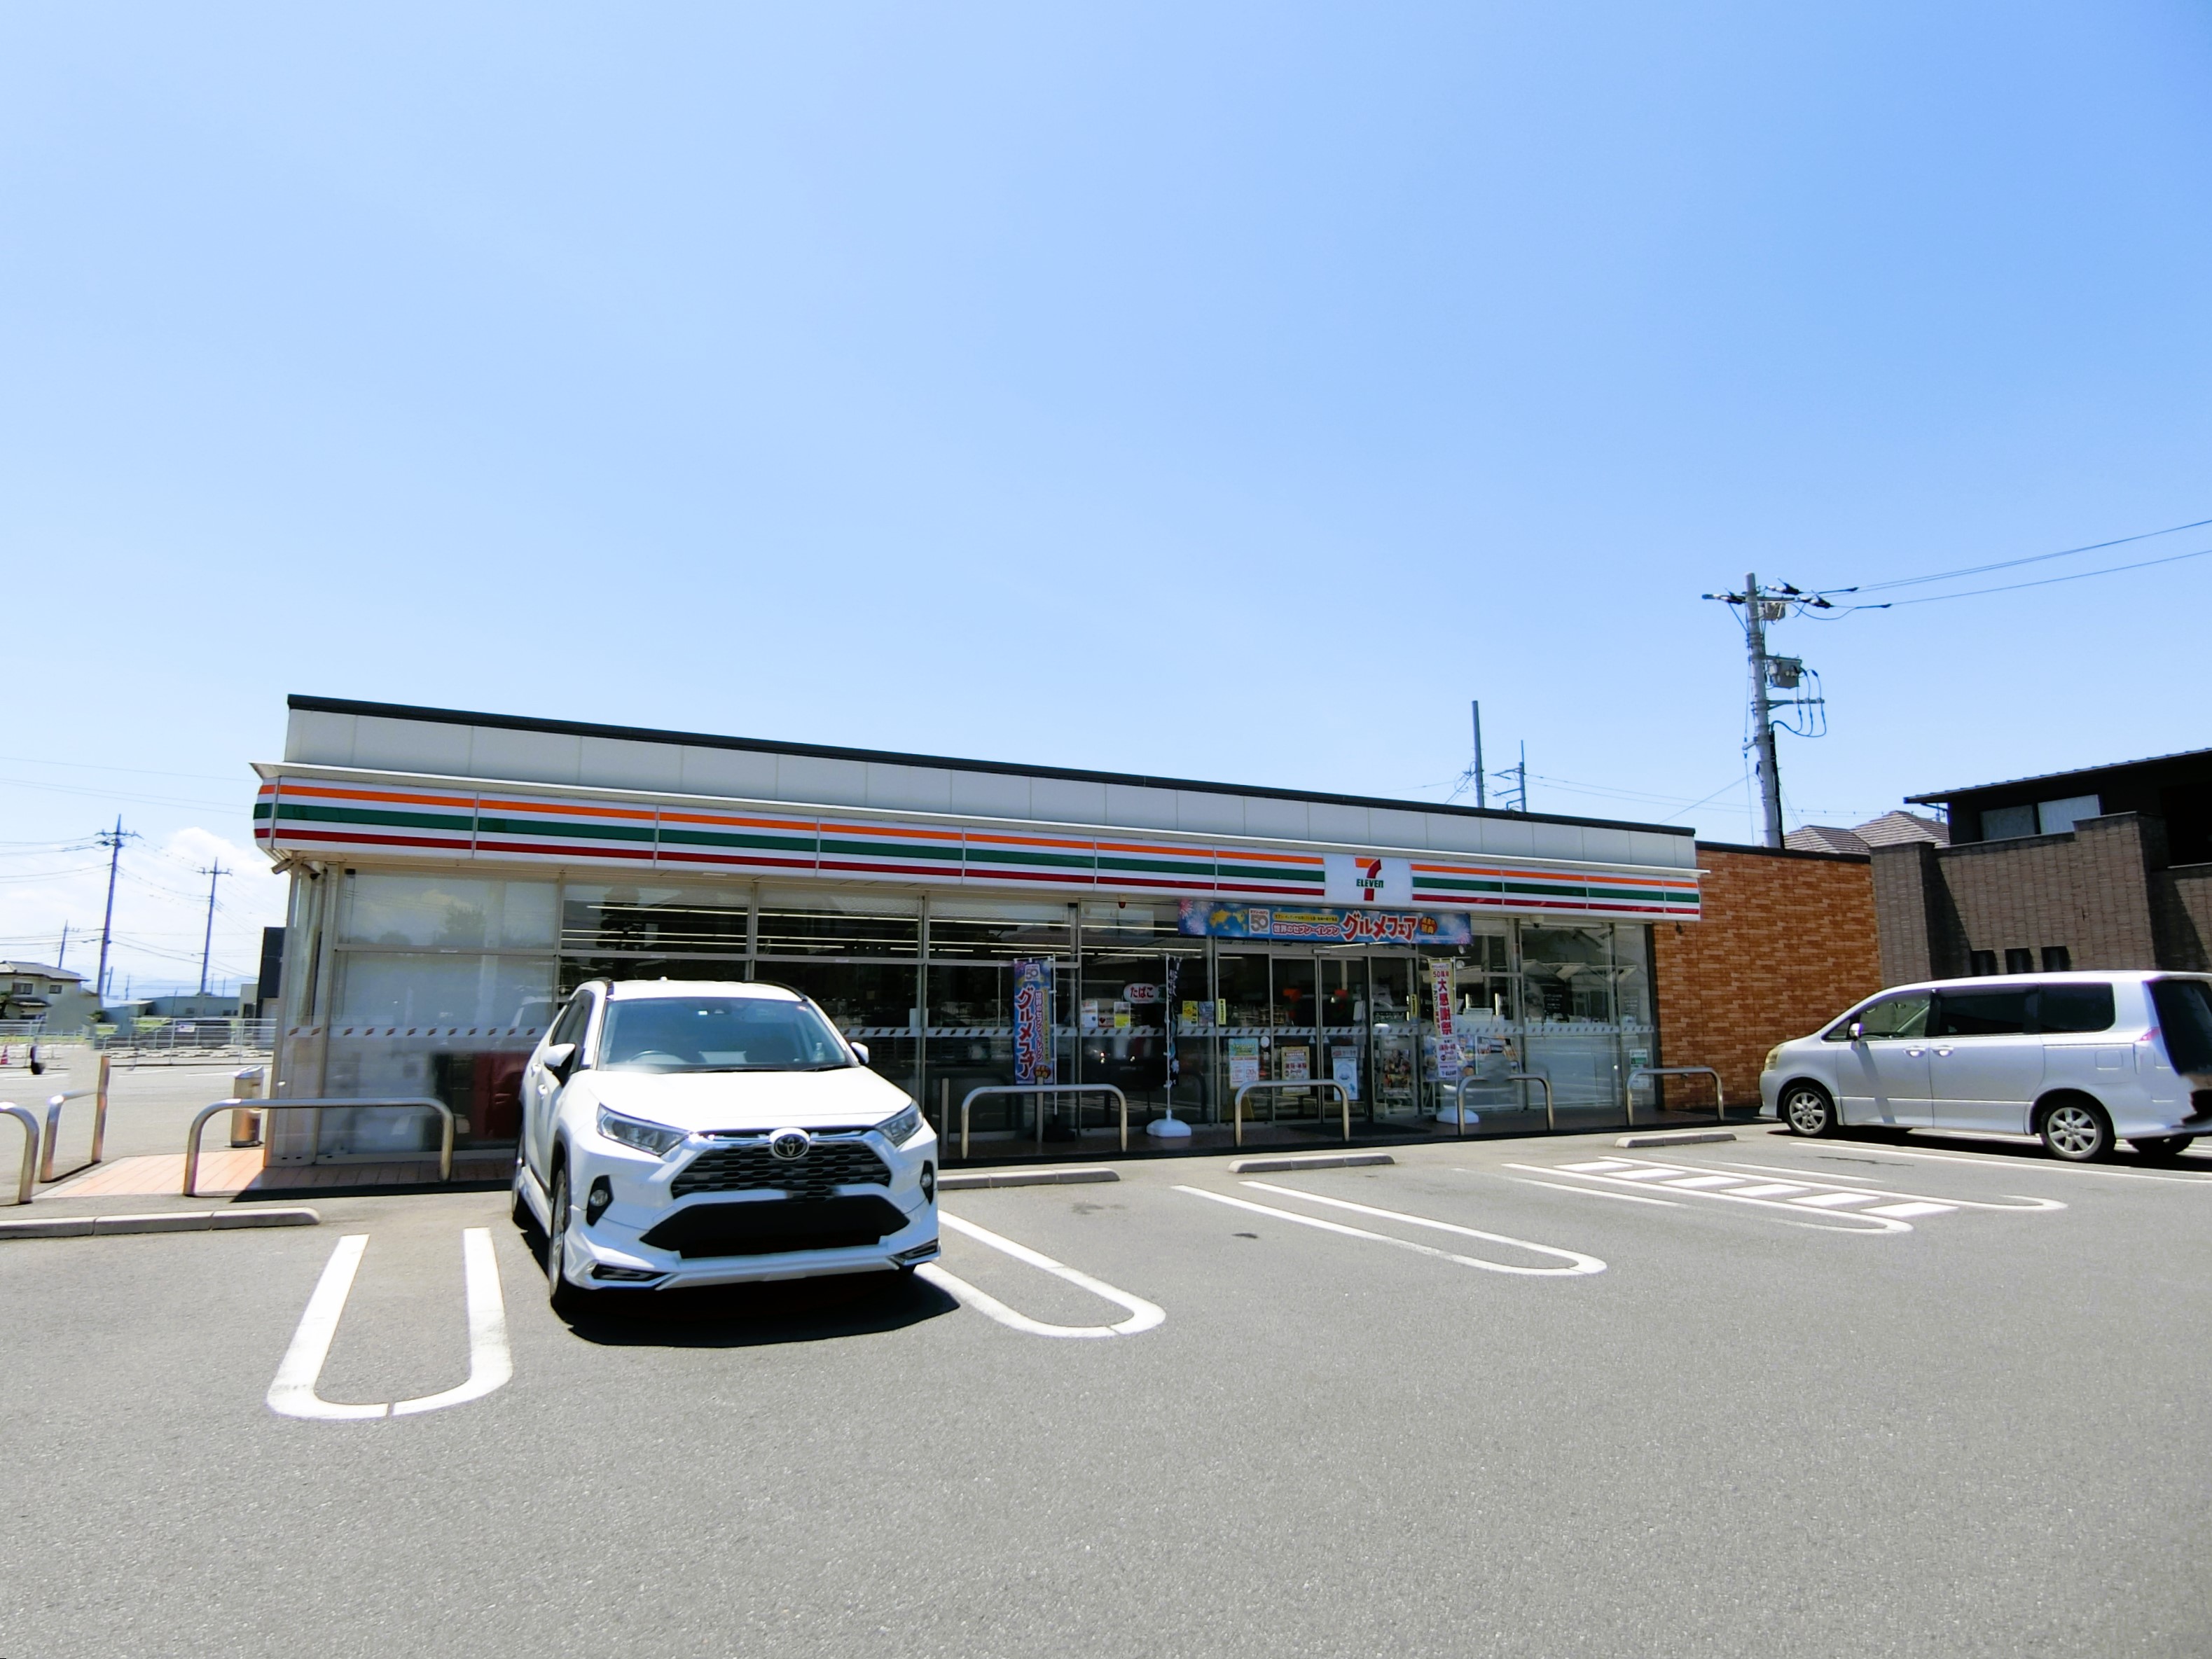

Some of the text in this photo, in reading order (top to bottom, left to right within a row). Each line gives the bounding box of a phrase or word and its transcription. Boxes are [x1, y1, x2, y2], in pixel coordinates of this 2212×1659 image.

[1341, 911, 1418, 941] グルメフェア
[1130, 986, 1154, 999] たばこ
[1017, 986, 1035, 1078] グルメフェア
